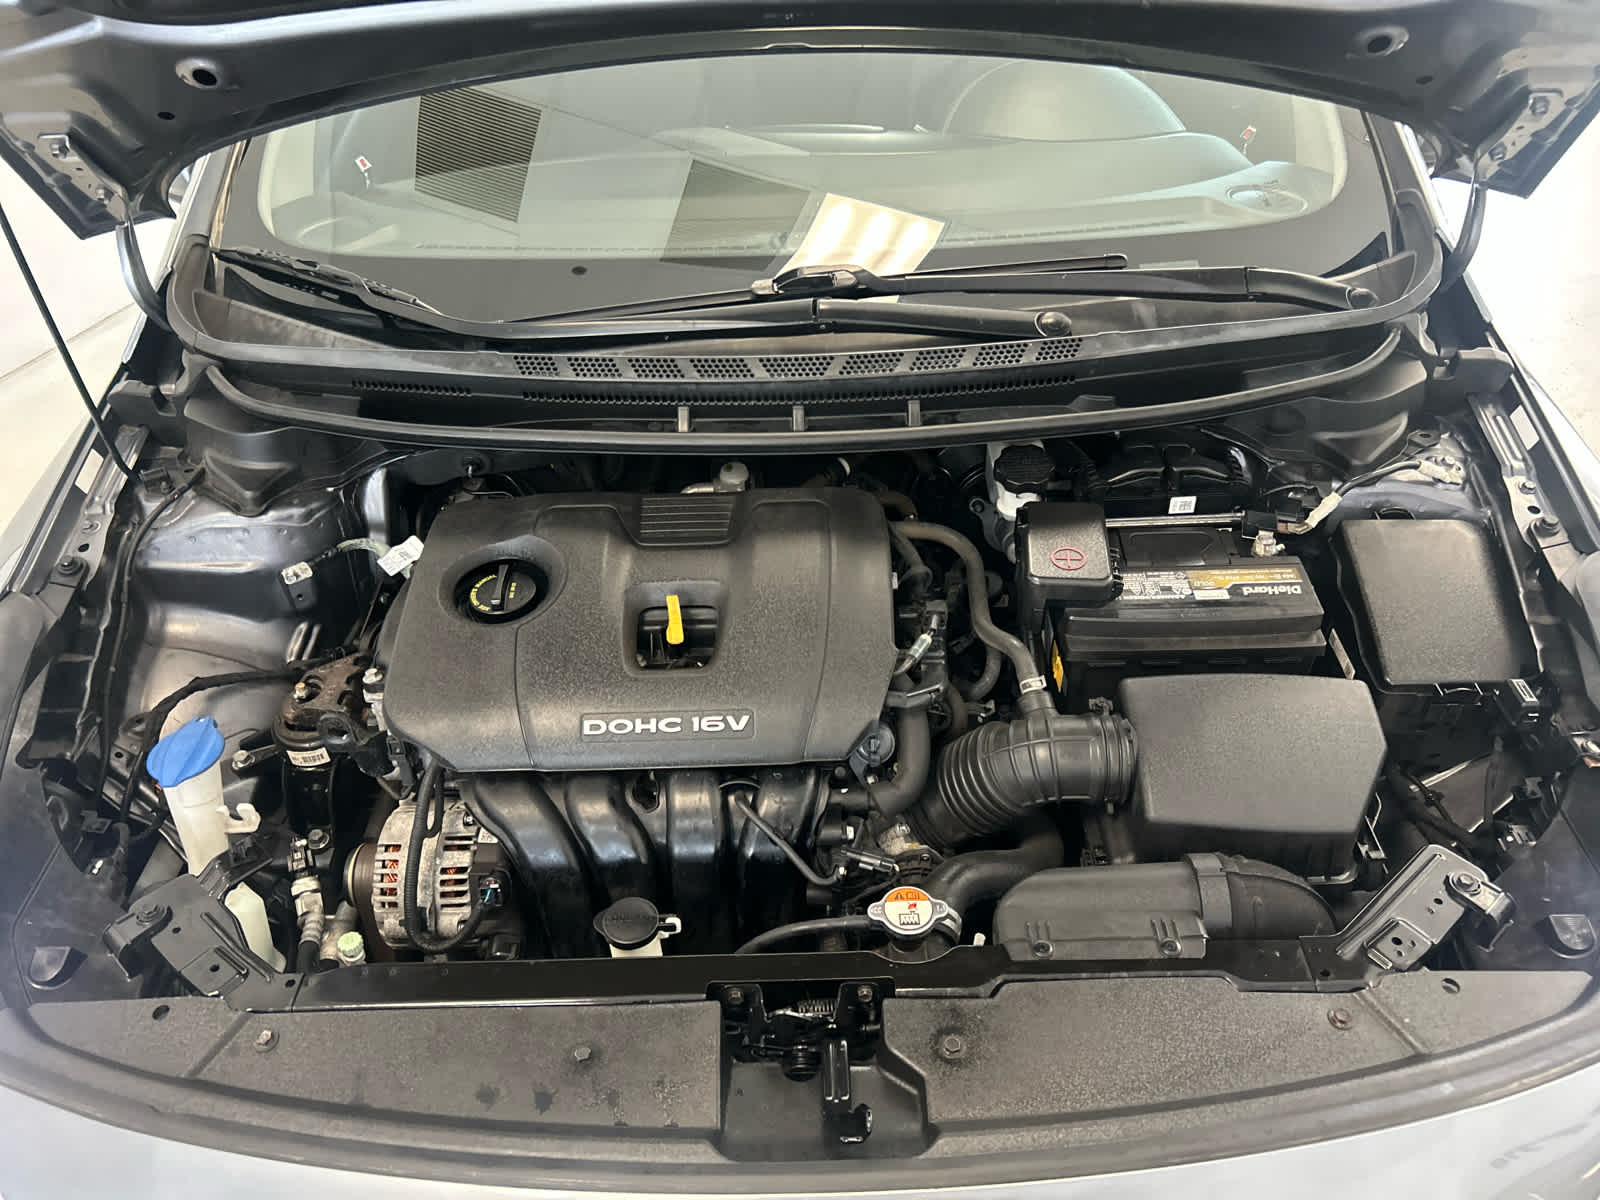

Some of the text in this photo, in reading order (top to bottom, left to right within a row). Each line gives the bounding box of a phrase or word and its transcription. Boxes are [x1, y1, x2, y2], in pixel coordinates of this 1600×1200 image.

[1242, 584, 1302, 596] DieHard
[583, 715, 750, 735] DOHC 16V
